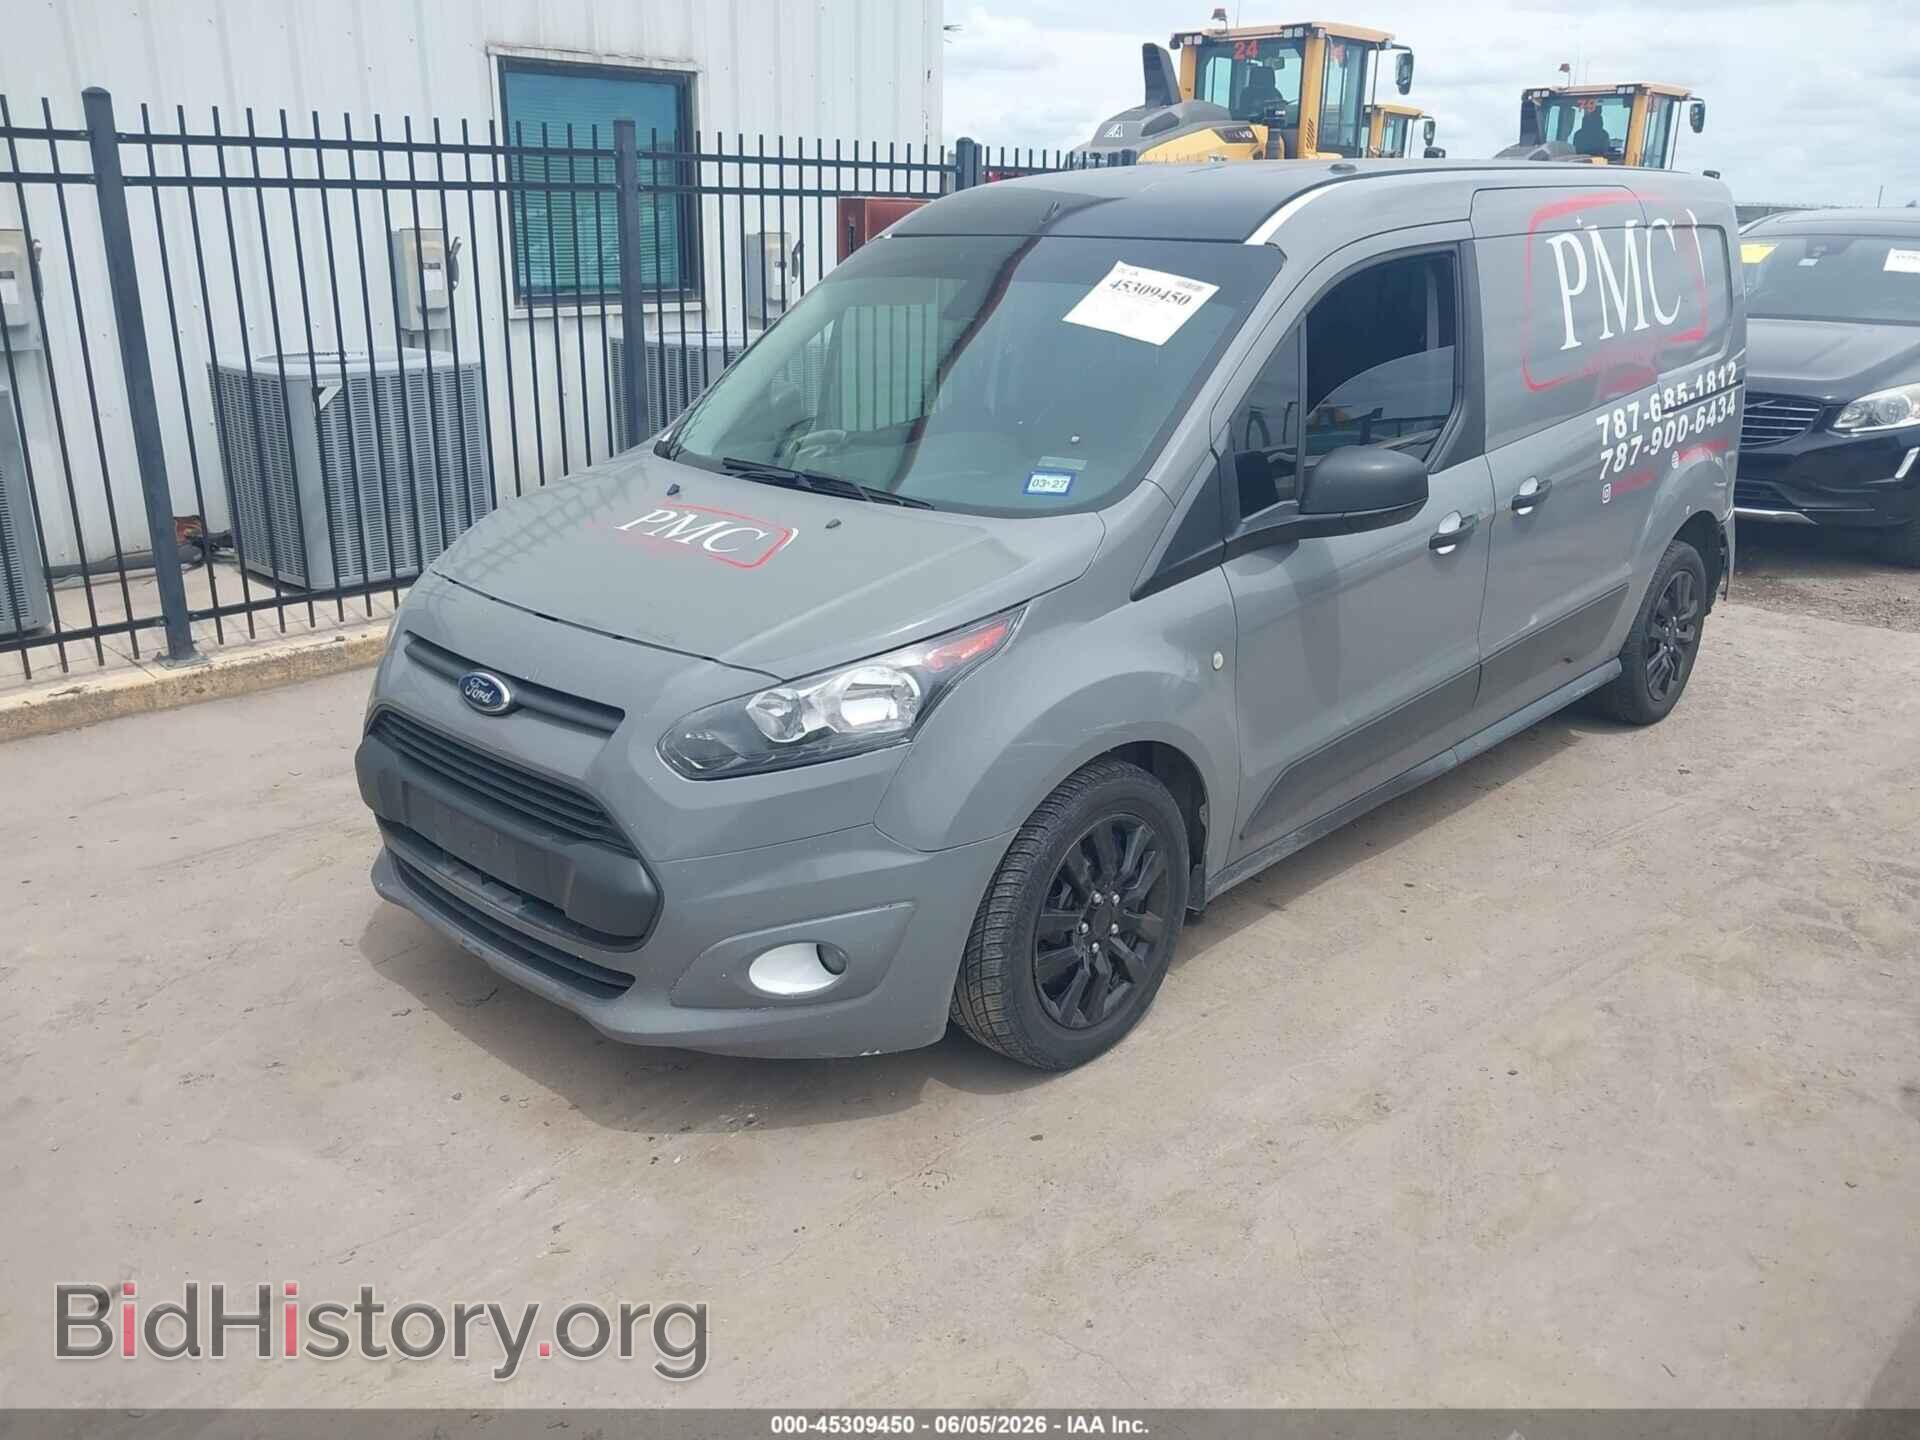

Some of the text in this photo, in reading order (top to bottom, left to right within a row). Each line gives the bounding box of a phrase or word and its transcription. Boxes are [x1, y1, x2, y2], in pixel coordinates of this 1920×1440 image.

[1109, 279, 1192, 305] 45309450
[1546, 218, 1681, 350] PMC
[1600, 391, 1736, 480] 787-900-6434
[614, 509, 769, 553] PMC
[465, 677, 495, 704] Ford
